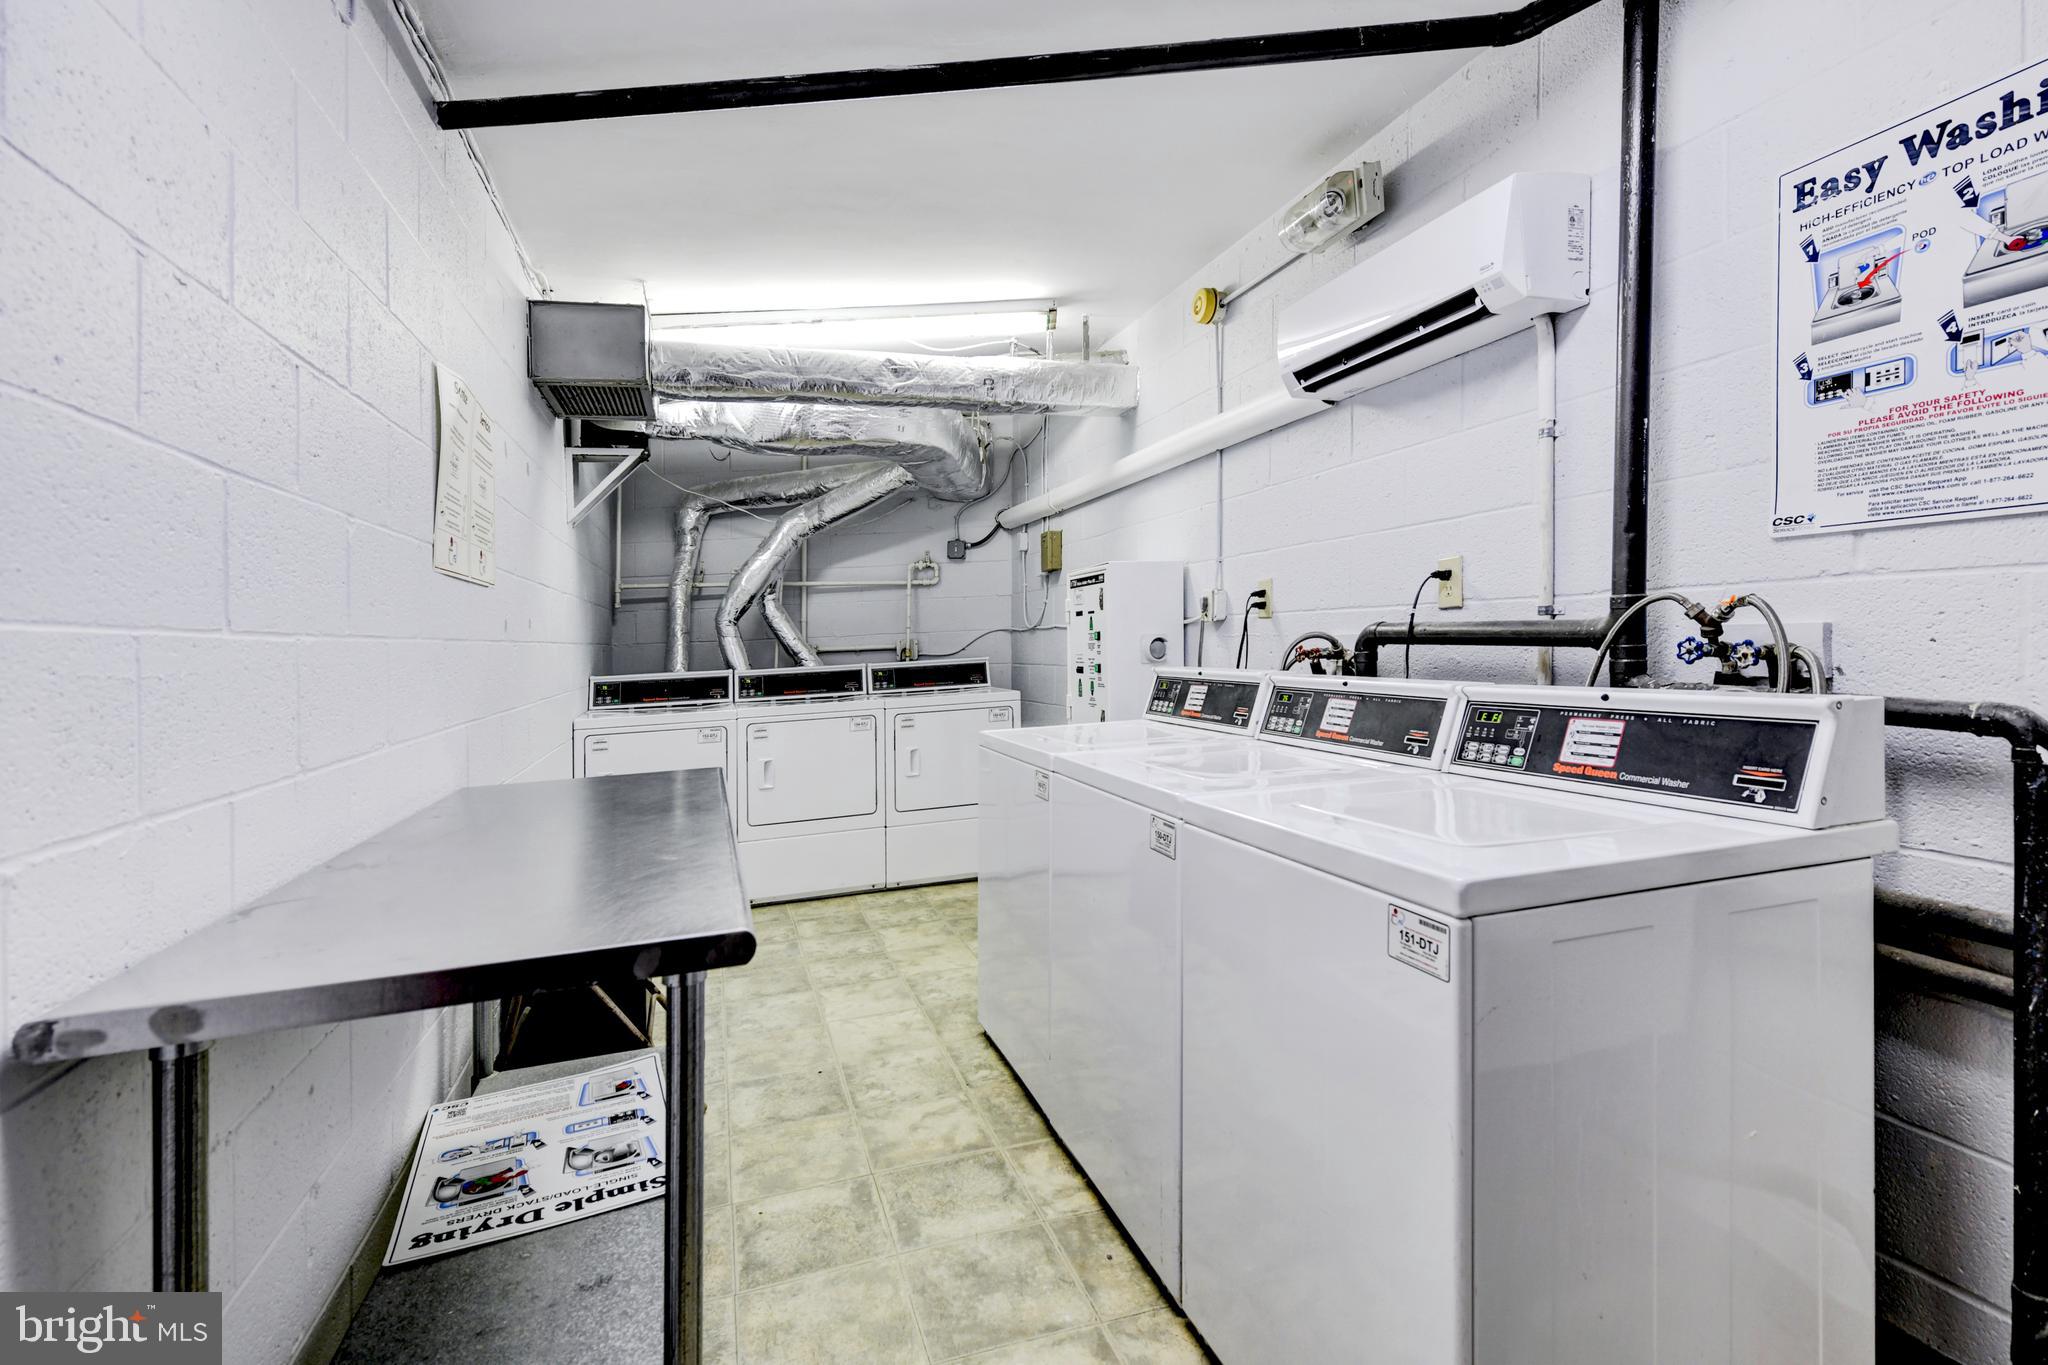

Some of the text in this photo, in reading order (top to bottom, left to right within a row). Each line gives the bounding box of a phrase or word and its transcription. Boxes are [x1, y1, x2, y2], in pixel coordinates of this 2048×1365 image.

[1941, 156, 1973, 178] TOP
[1980, 135, 2027, 163] LOAD
[1792, 155, 1888, 213] Easy
[1963, 188, 1976, 200] 2
[1912, 227, 1937, 241] POD
[1968, 311, 1994, 322] INSERT
[1946, 323, 1958, 335] 4
[1800, 362, 1809, 373] 3
[1857, 388, 2025, 426] PLEASE AVOID THE FOLLOWING
[1888, 388, 1986, 413] FOR YOUR SAFETY
[1854, 424, 1879, 432] PROPIA
[1928, 411, 1944, 419] POR
[1947, 406, 1973, 415] FAVOR
[1976, 401, 2000, 410] EVITE
[1772, 515, 1805, 526] CSC
[1683, 719, 1717, 727] FABRIC
[1552, 762, 1690, 789] Speed Queen Commercial Washer
[1399, 929, 1439, 955] 151-DTJ
[408, 1176, 666, 1250] Simple Drying
[446, 1208, 503, 1226] DRYERS
